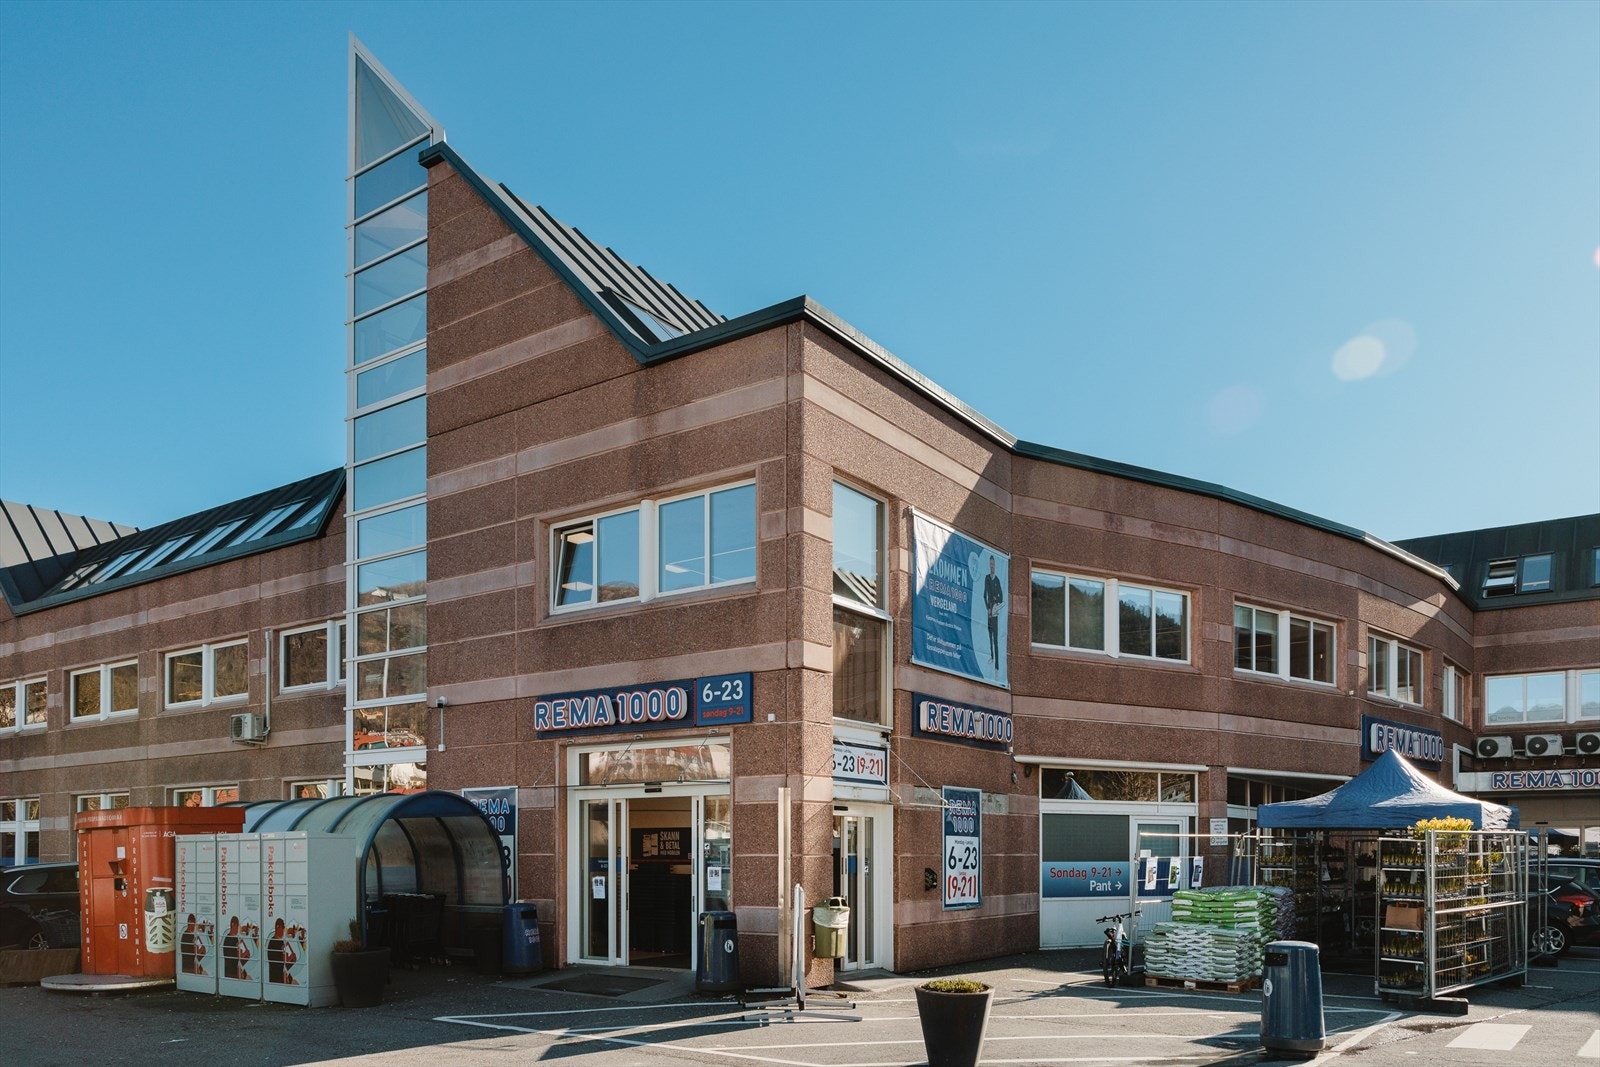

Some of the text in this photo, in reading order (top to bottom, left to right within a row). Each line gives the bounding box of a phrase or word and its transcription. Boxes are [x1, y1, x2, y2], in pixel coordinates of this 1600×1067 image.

[929, 557, 968, 587] KOMMEN
[702, 679, 744, 703] 6-23
[534, 687, 685, 731] REMA 1000
[702, 706, 744, 719] søndag 9-21
[927, 701, 1013, 743] REMA 1000
[1375, 723, 1445, 763] REMA 1000
[857, 756, 884, 777] (9-21)
[1492, 769, 1600, 789] REMA 10
[949, 799, 977, 816] REMA
[952, 816, 975, 833] 1000
[660, 831, 680, 841] SKANN
[666, 841, 680, 850] BETAL
[948, 846, 978, 870] 6-23
[1050, 867, 1112, 880] Søndag 9-21
[948, 874, 977, 900] (9-21)
[1089, 880, 1112, 892] Pant
[82, 840, 91, 963] PROPANAUTOMAT
[132, 837, 140, 966] PROPANAUTOMAT
